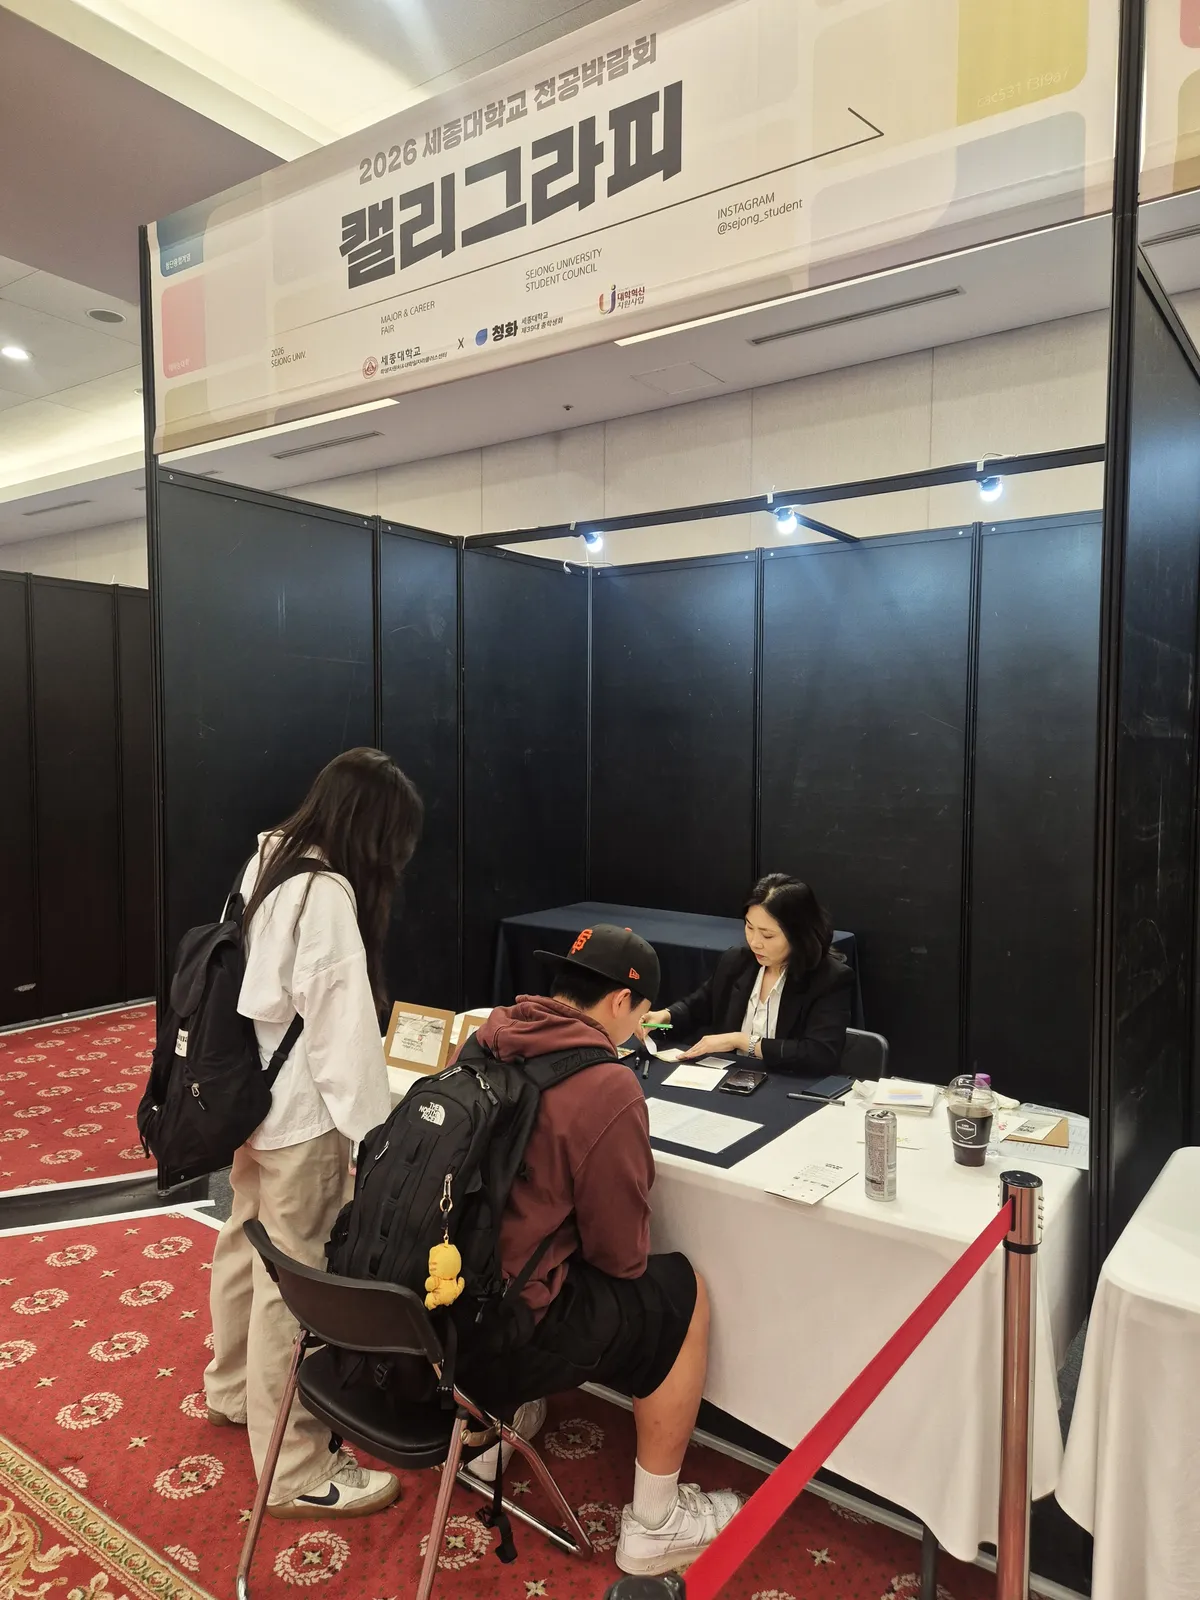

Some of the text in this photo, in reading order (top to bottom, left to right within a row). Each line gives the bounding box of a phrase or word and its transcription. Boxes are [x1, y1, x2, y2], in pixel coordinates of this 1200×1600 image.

[359, 33, 657, 185] 2026 세종대학교 전공박람회
[339, 81, 683, 289] 캘리그라피
[717, 192, 775, 219] INSTAGRAM
[717, 199, 803, 235] @sejong_student
[525, 247, 603, 280] SEJONG UNIVERSITY
[525, 263, 598, 293] STUDENT COUNCIL
[617, 286, 645, 301] 대학혁신
[617, 295, 645, 310] 지원사업
[380, 300, 436, 324] MAJOR & CAREER
[521, 311, 548, 325] 세종대학교
[380, 324, 395, 336] FAIR
[492, 320, 518, 342] 청화
[520, 316, 564, 334] 제39대 총학생회
[271, 346, 285, 358] 2026
[271, 350, 307, 368] SEJONG UNIV.
[380, 346, 421, 366] 세종대학교
